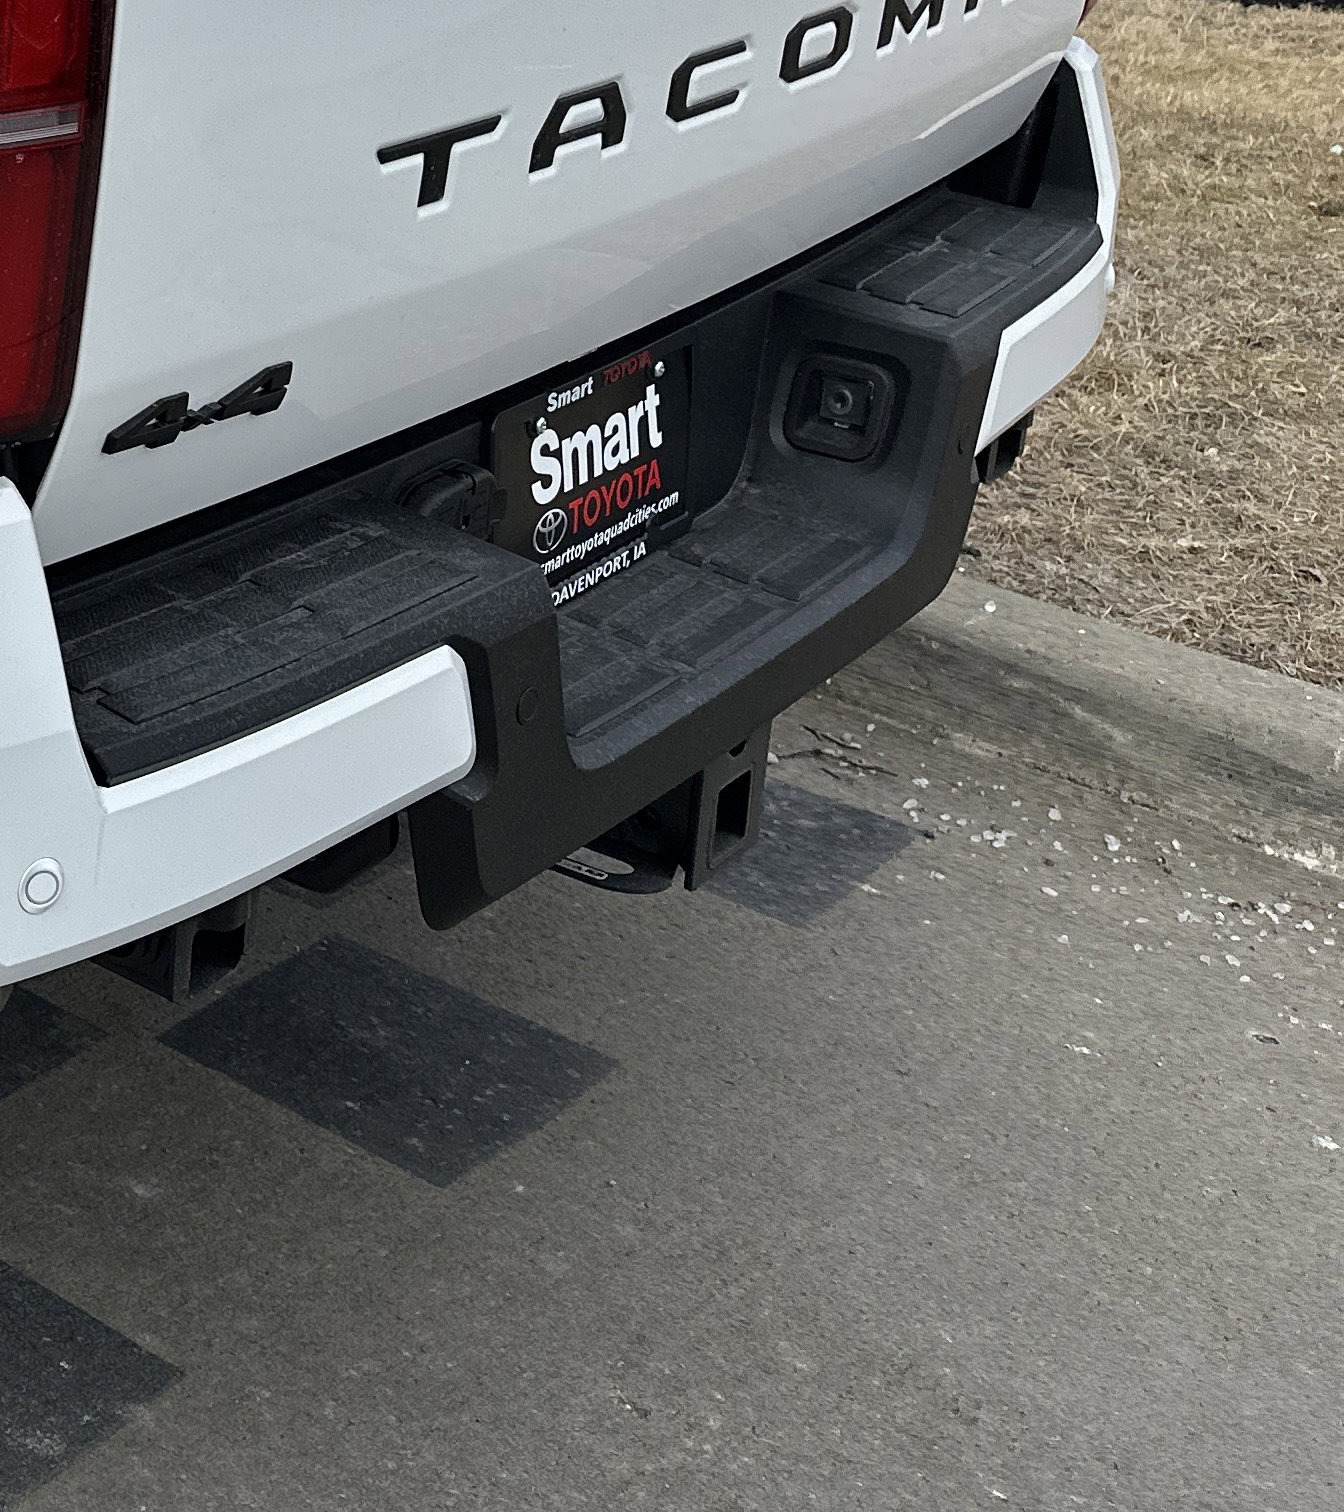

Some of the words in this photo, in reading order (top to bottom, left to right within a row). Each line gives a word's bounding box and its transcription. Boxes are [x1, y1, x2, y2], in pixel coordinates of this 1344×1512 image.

[546, 376, 594, 412] Smart
[602, 350, 653, 387] TOYOTA
[530, 383, 662, 505] Smart
[568, 458, 662, 534] TOYOTA
[633, 541, 647, 561] IA
